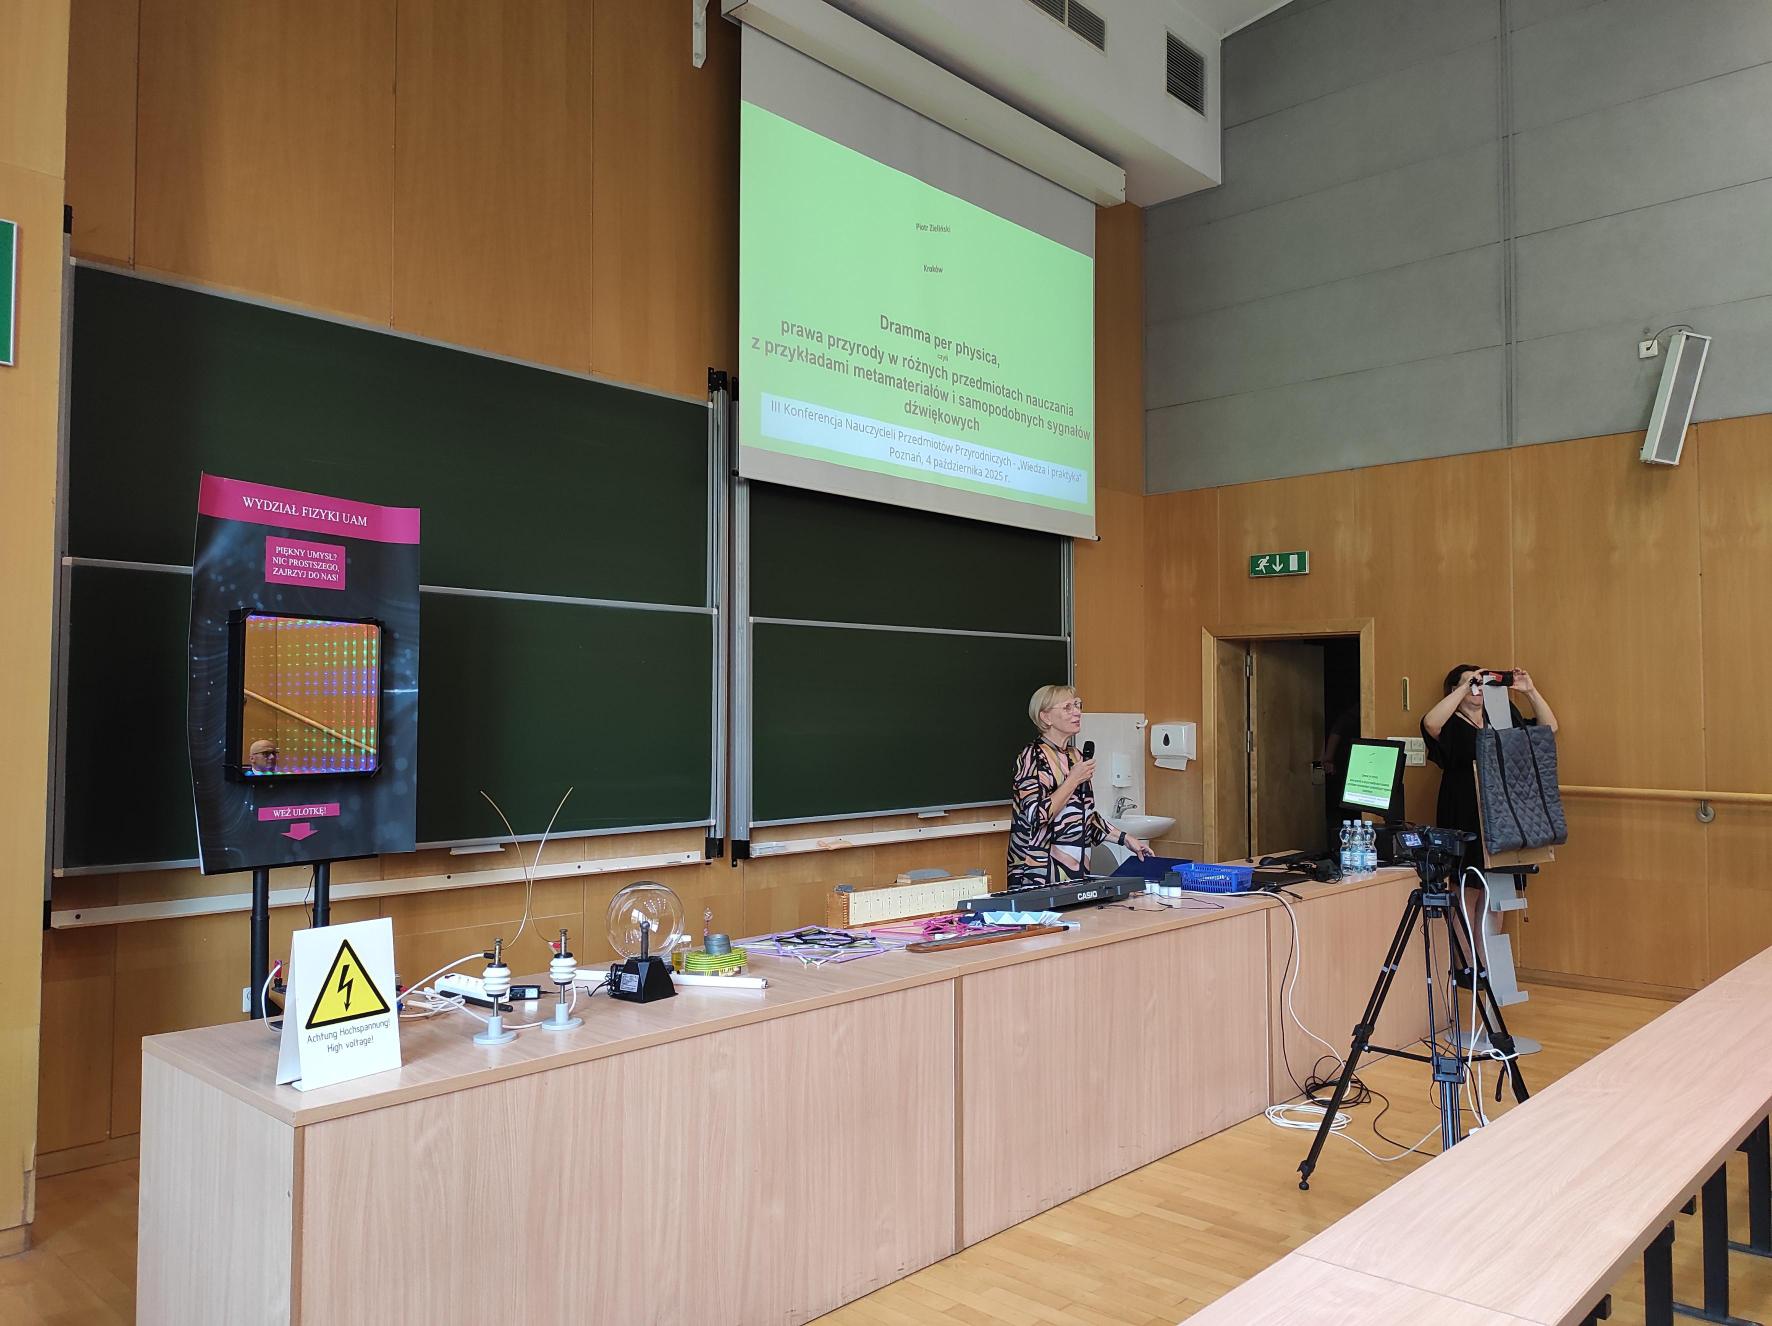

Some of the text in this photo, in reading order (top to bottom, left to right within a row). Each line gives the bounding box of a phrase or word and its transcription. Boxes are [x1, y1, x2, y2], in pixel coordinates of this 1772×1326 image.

[880, 314, 1000, 368] Dramma per physica,
[781, 319, 1074, 417] prawa przyrody w różnych przedmiotach nauczania
[751, 336, 1091, 441] z przykładami metamateriałów i samopodobnych sygnałów
[904, 399, 980, 432] dźwiękowych
[771, 400, 781, 413] III
[784, 402, 843, 431] Konferencja
[845, 418, 896, 441] Nauczycieli
[898, 430, 955, 453] Przedmiotów
[955, 443, 1012, 468] Przyrodniczych
[889, 446, 924, 465] Poznań,
[925, 455, 932, 465] 4
[933, 456, 983, 478] października
[985, 467, 1004, 481] 2025
[243, 496, 368, 526] WYDZIAŁ FIZYKI UAM
[272, 556, 340, 572] NIC PROSTSZEGO,
[276, 546, 306, 557] PIĘKNY
[272, 567, 339, 582] ZAJRZYJ DO NAS!
[1077, 890, 1098, 901] CASIO
[307, 1018, 391, 1043] Achtung Hochspannung!
[327, 1035, 374, 1053] High voltage!
